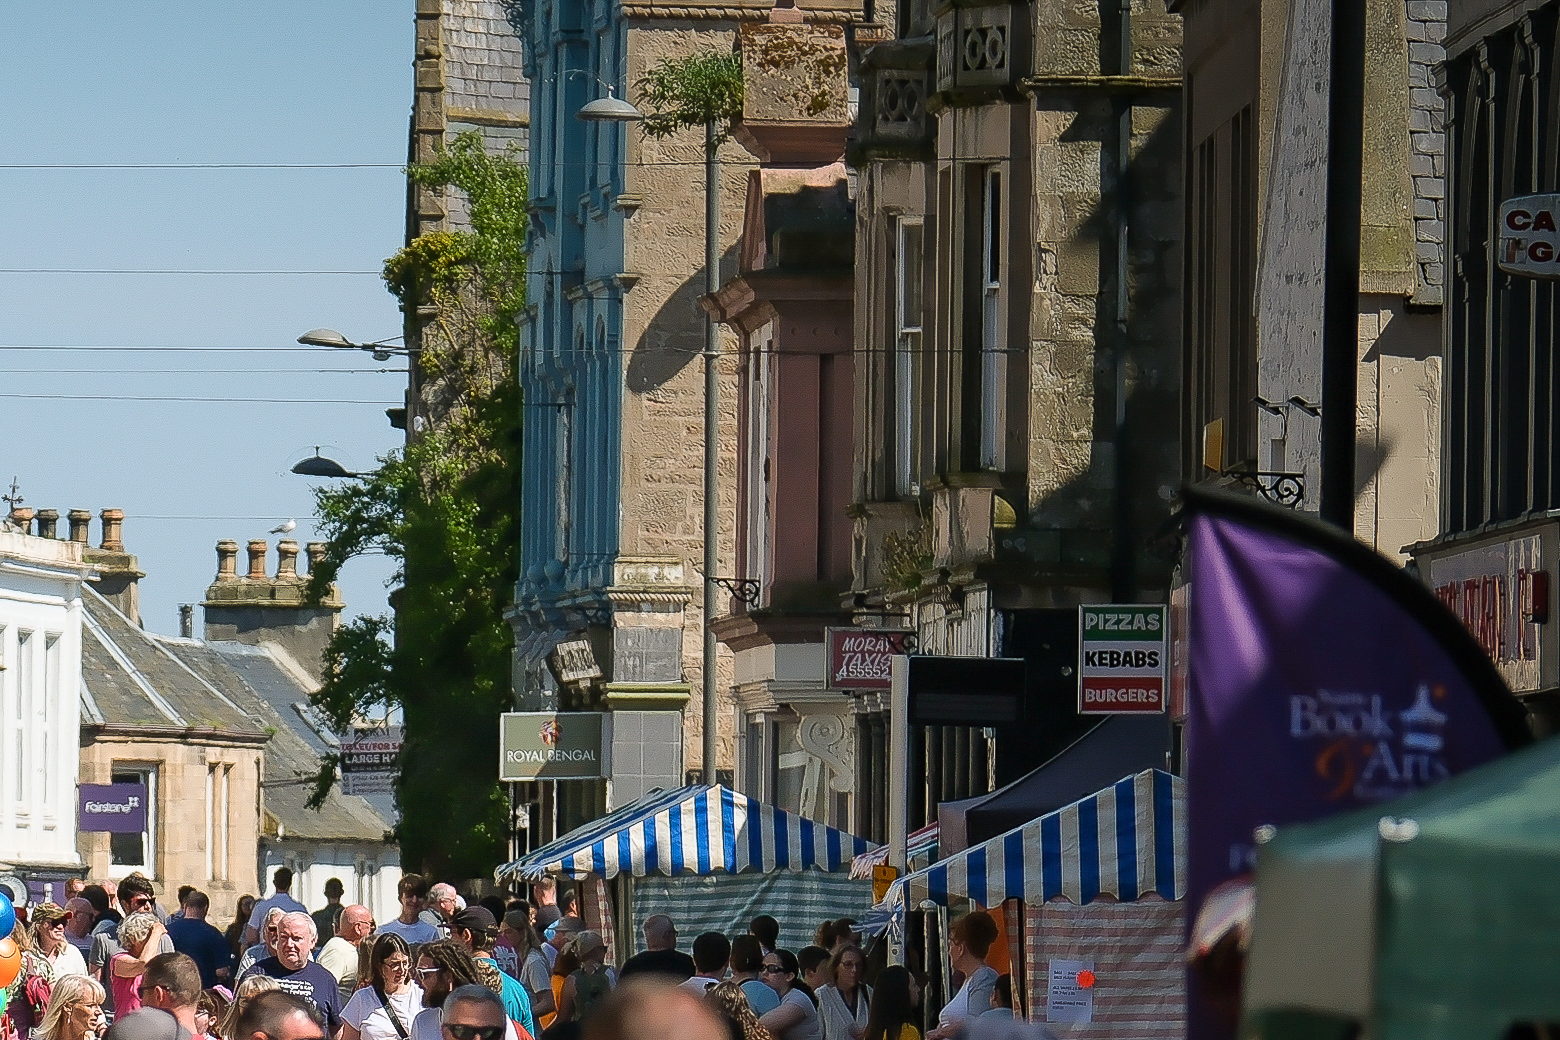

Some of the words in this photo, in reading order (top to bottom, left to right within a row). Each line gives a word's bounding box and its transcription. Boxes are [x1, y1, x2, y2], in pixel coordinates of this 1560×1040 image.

[1528, 241, 1560, 263] G
[1085, 613, 1160, 630] PIZZAS
[842, 636, 894, 652] MORAY
[842, 653, 892, 672] TAXIS
[1084, 649, 1160, 668] KEBABS
[1085, 688, 1159, 702] BURGERS
[1290, 694, 1393, 738] Book
[345, 755, 380, 764] LARGE
[507, 750, 545, 764] ROYAL
[548, 749, 596, 762] BENGAL
